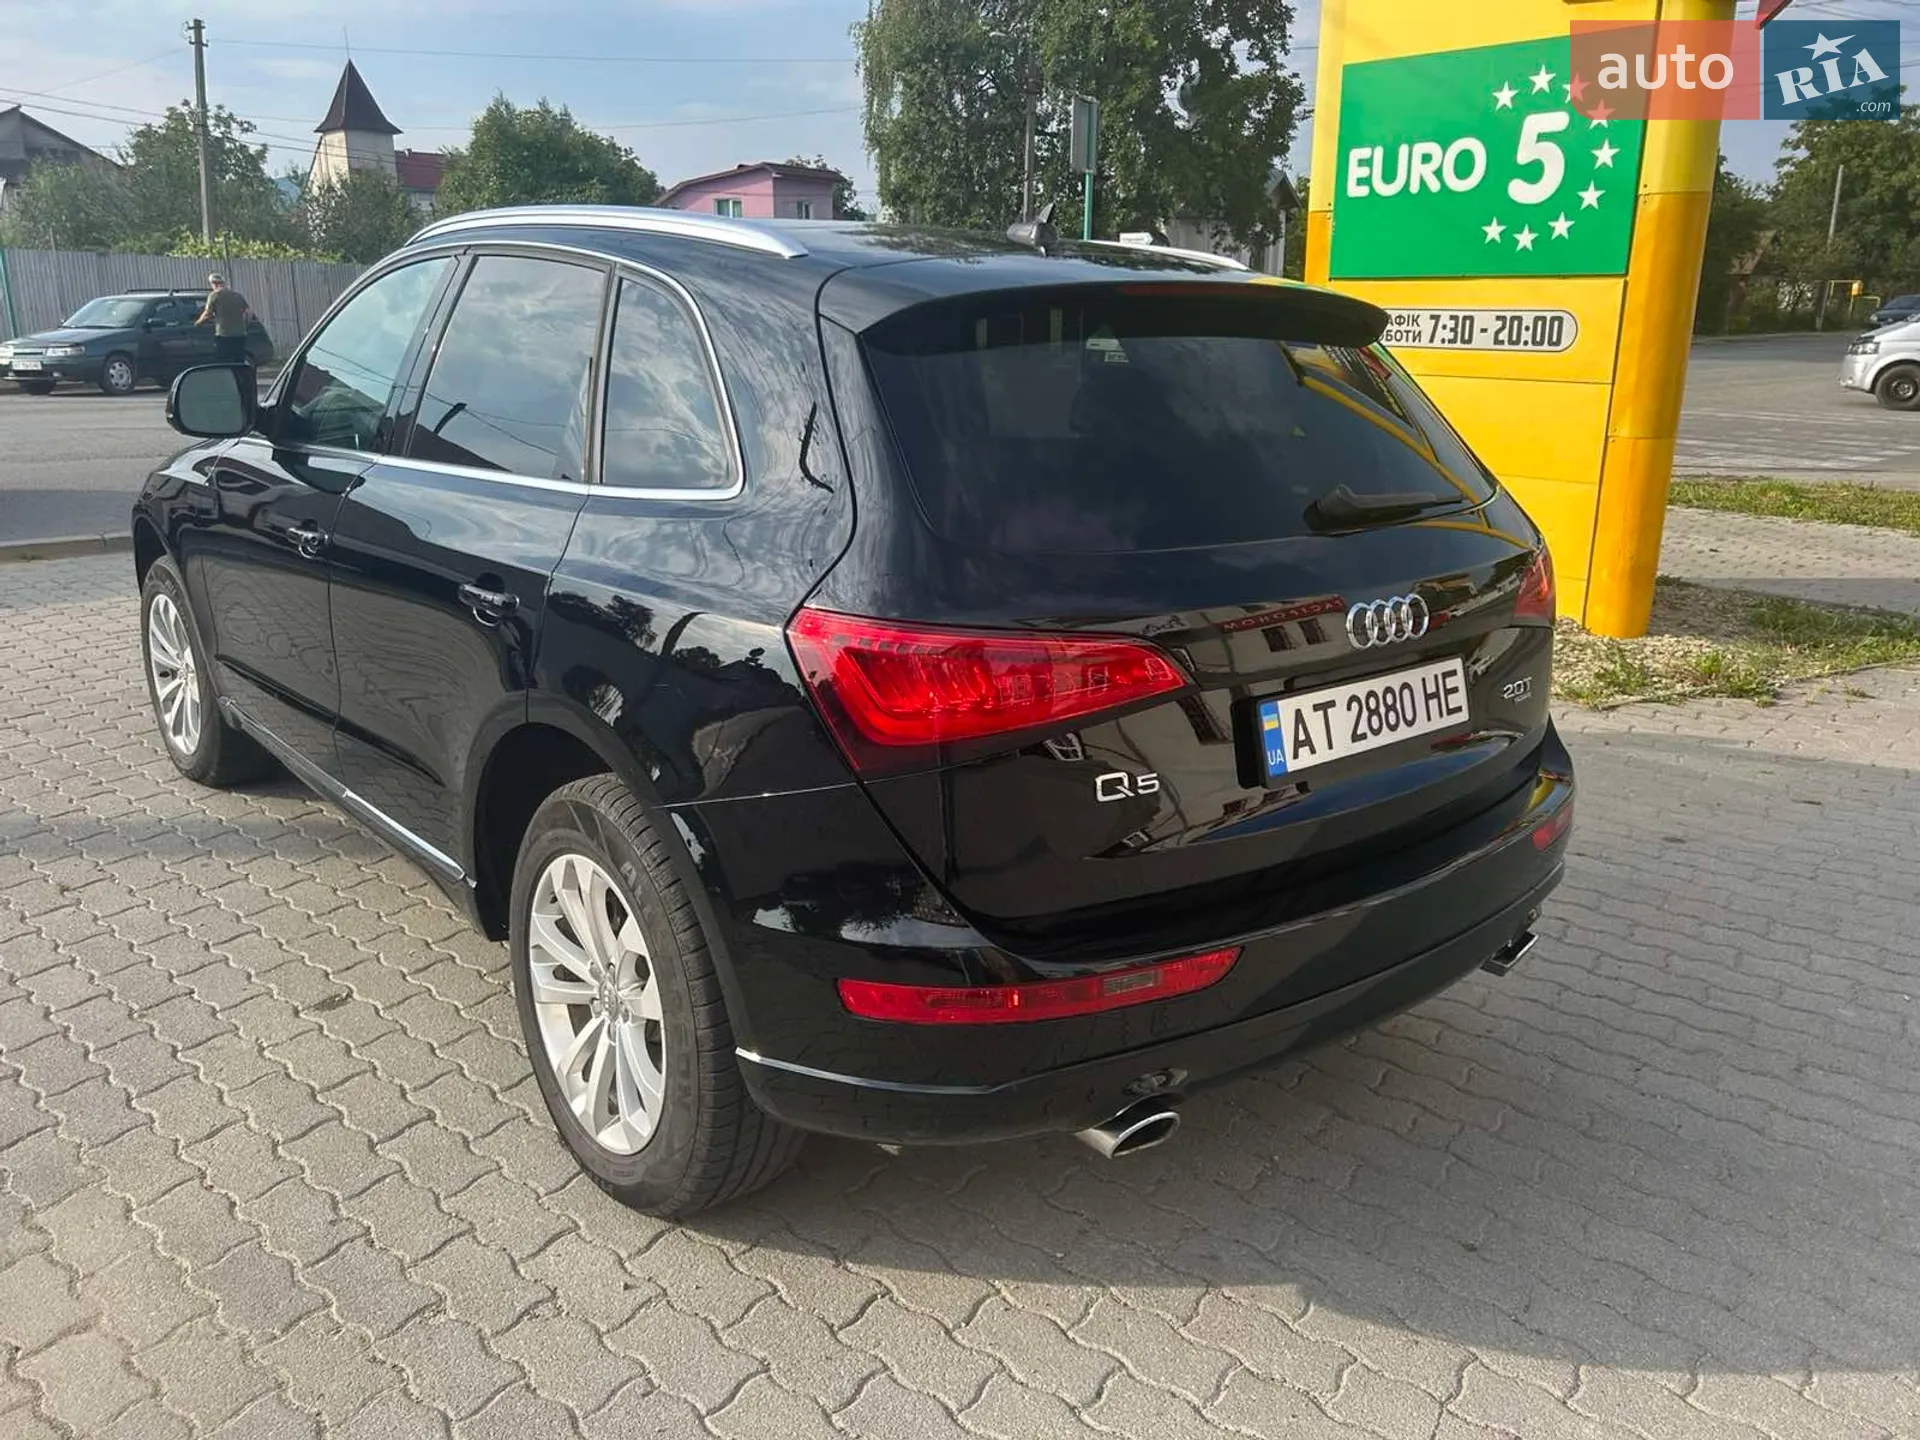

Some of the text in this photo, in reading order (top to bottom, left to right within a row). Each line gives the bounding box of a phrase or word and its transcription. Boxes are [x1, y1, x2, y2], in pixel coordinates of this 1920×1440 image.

[1347, 111, 1570, 205] EURO 5
[1388, 314, 1421, 327] АФІК
[1428, 314, 1475, 345] 7:30
[1492, 314, 1565, 347] 20:00
[1380, 329, 1422, 343] БОТИ
[1292, 668, 1463, 760] AT 2880 HE
[1267, 749, 1284, 766] UA
